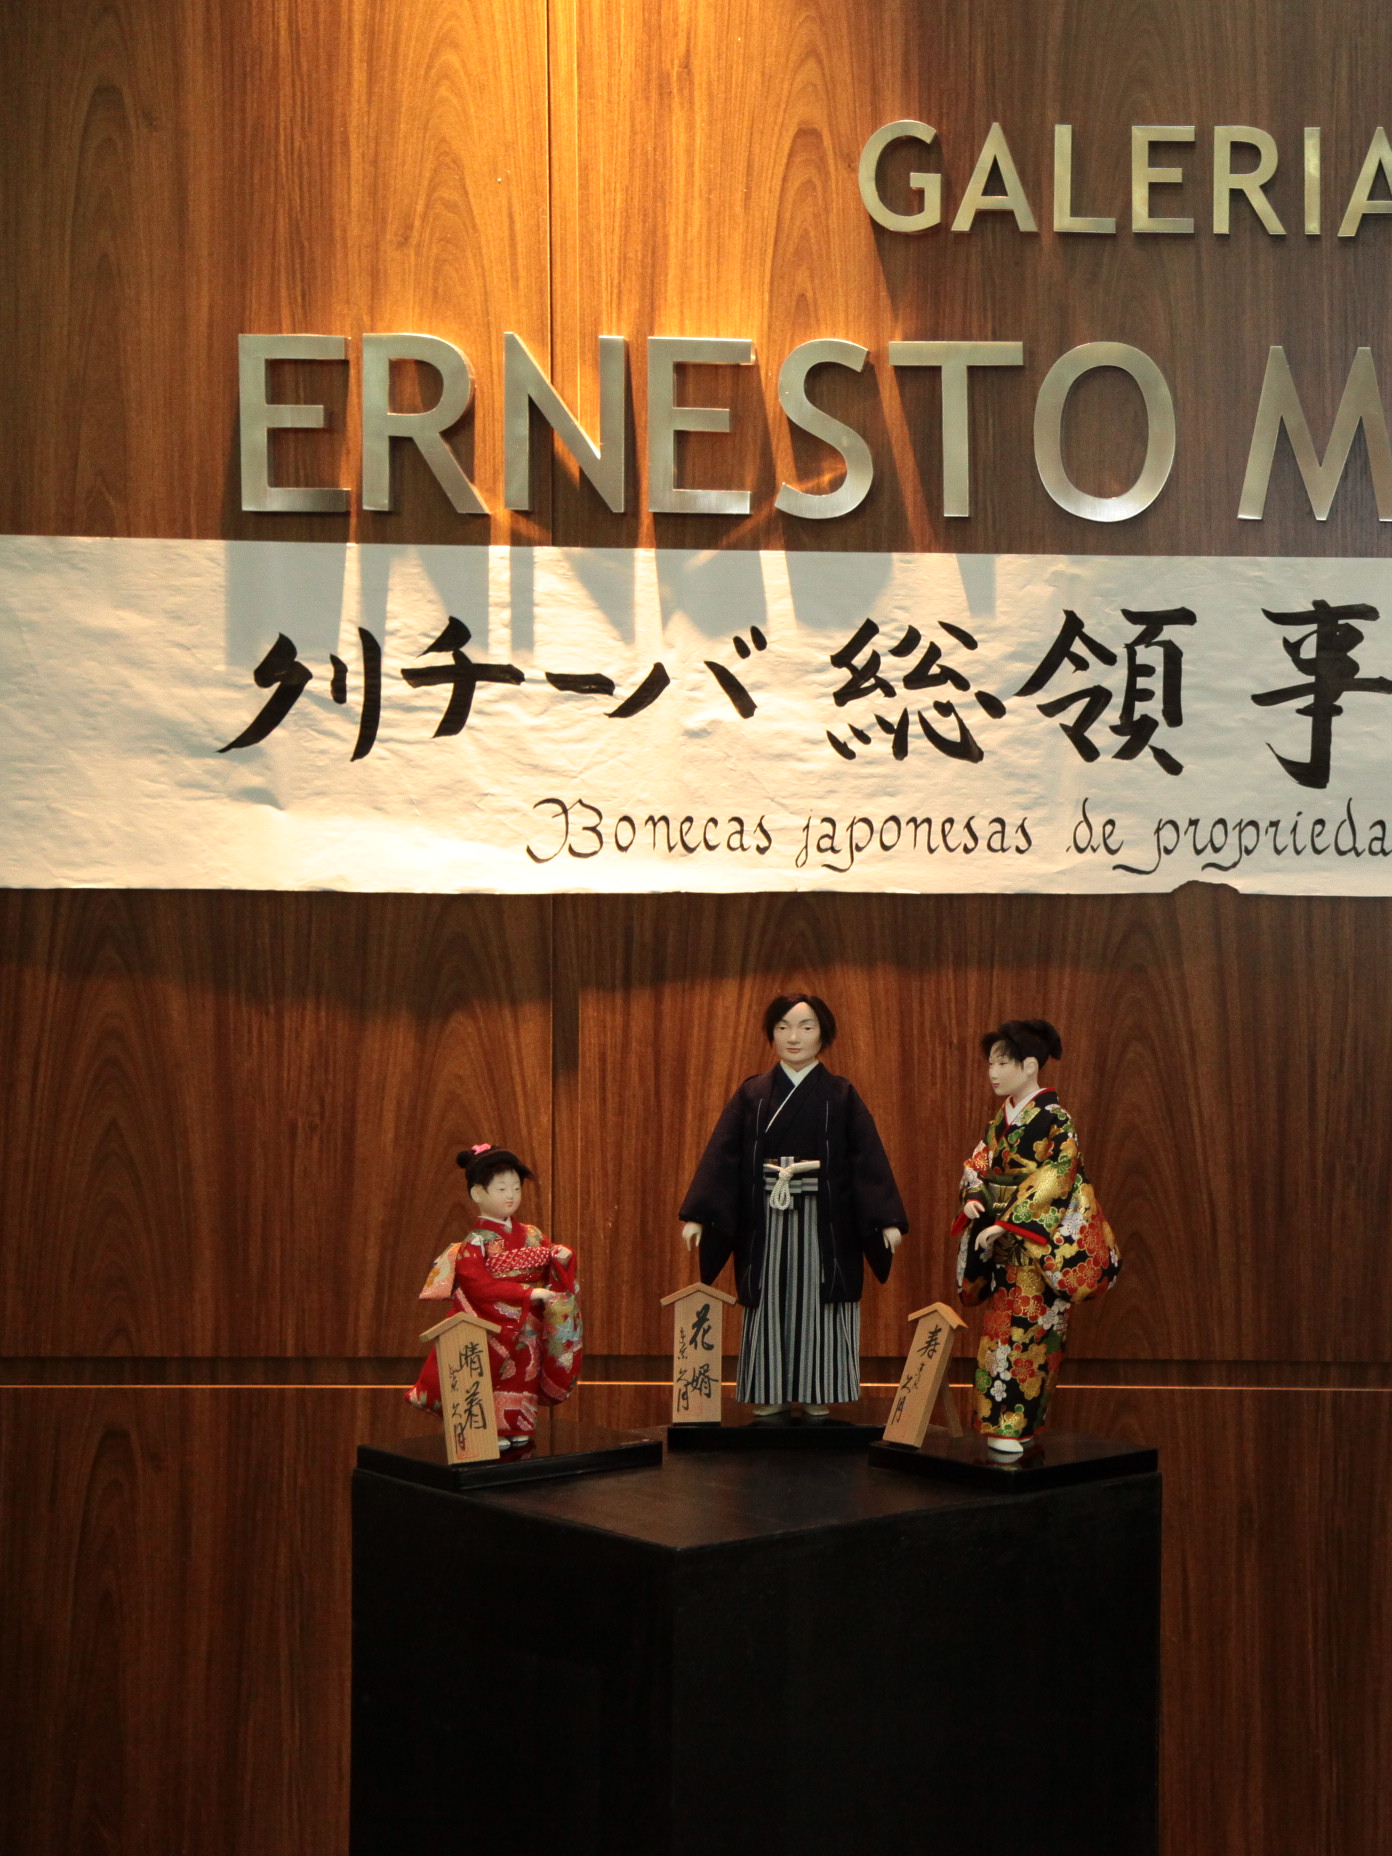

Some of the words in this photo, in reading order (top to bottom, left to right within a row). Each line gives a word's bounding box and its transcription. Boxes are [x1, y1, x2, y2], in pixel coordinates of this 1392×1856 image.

[238, 332, 1176, 523] ERNESTO
[526, 798, 772, 864] Bonecas
[795, 808, 1032, 872] japonesas
[1067, 798, 1123, 855] de
